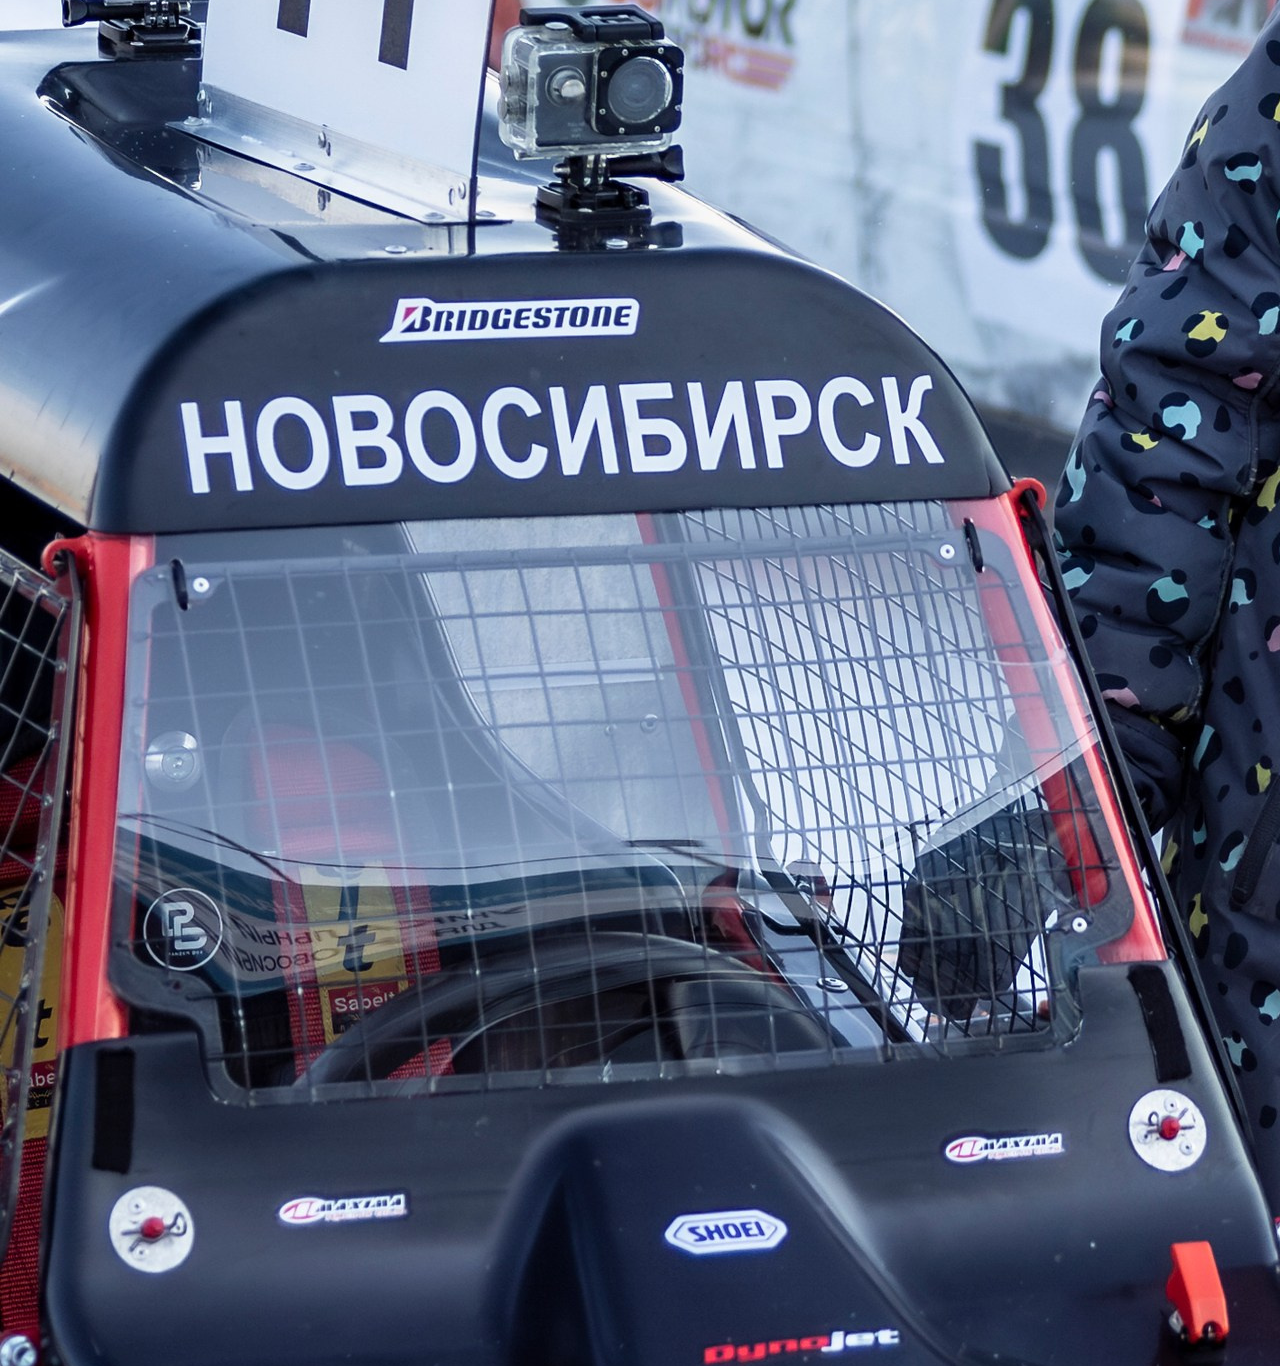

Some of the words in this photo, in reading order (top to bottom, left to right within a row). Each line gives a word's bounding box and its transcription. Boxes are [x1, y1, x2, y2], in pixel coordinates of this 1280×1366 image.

[399, 302, 634, 334] BRIDGESTONE
[180, 374, 946, 495] НОВОСИБИРСК
[688, 1221, 766, 1243] SHOEI
